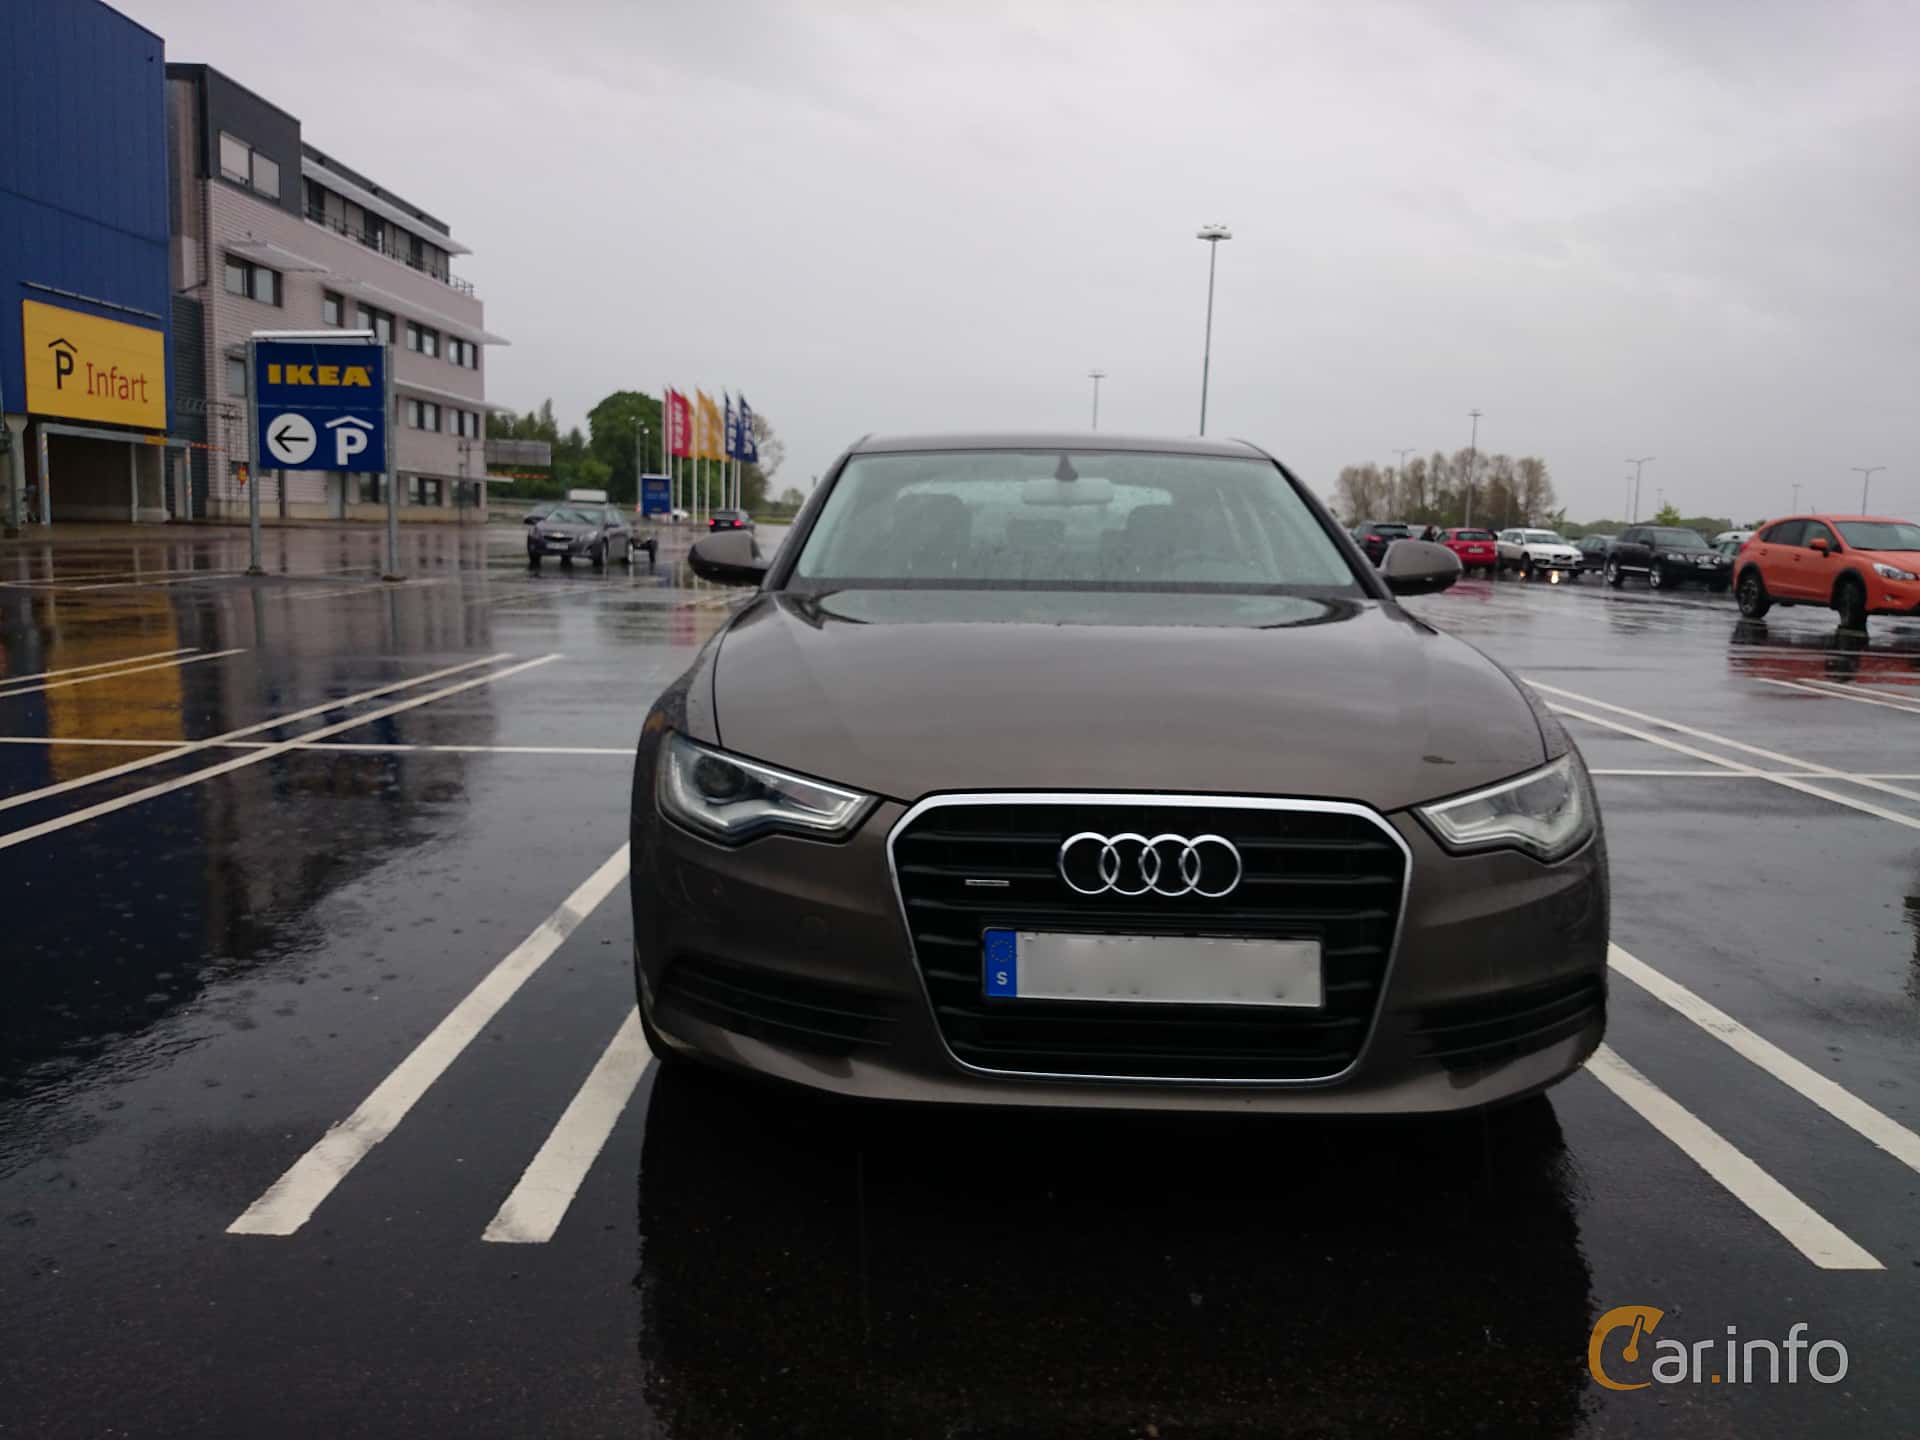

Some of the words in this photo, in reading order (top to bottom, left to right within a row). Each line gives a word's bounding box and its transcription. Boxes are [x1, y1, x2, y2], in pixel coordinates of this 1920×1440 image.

[56, 350, 74, 390] P
[86, 362, 149, 404] Infart
[267, 364, 372, 387] IKEA
[336, 427, 368, 466] P
[996, 971, 1008, 985] S
